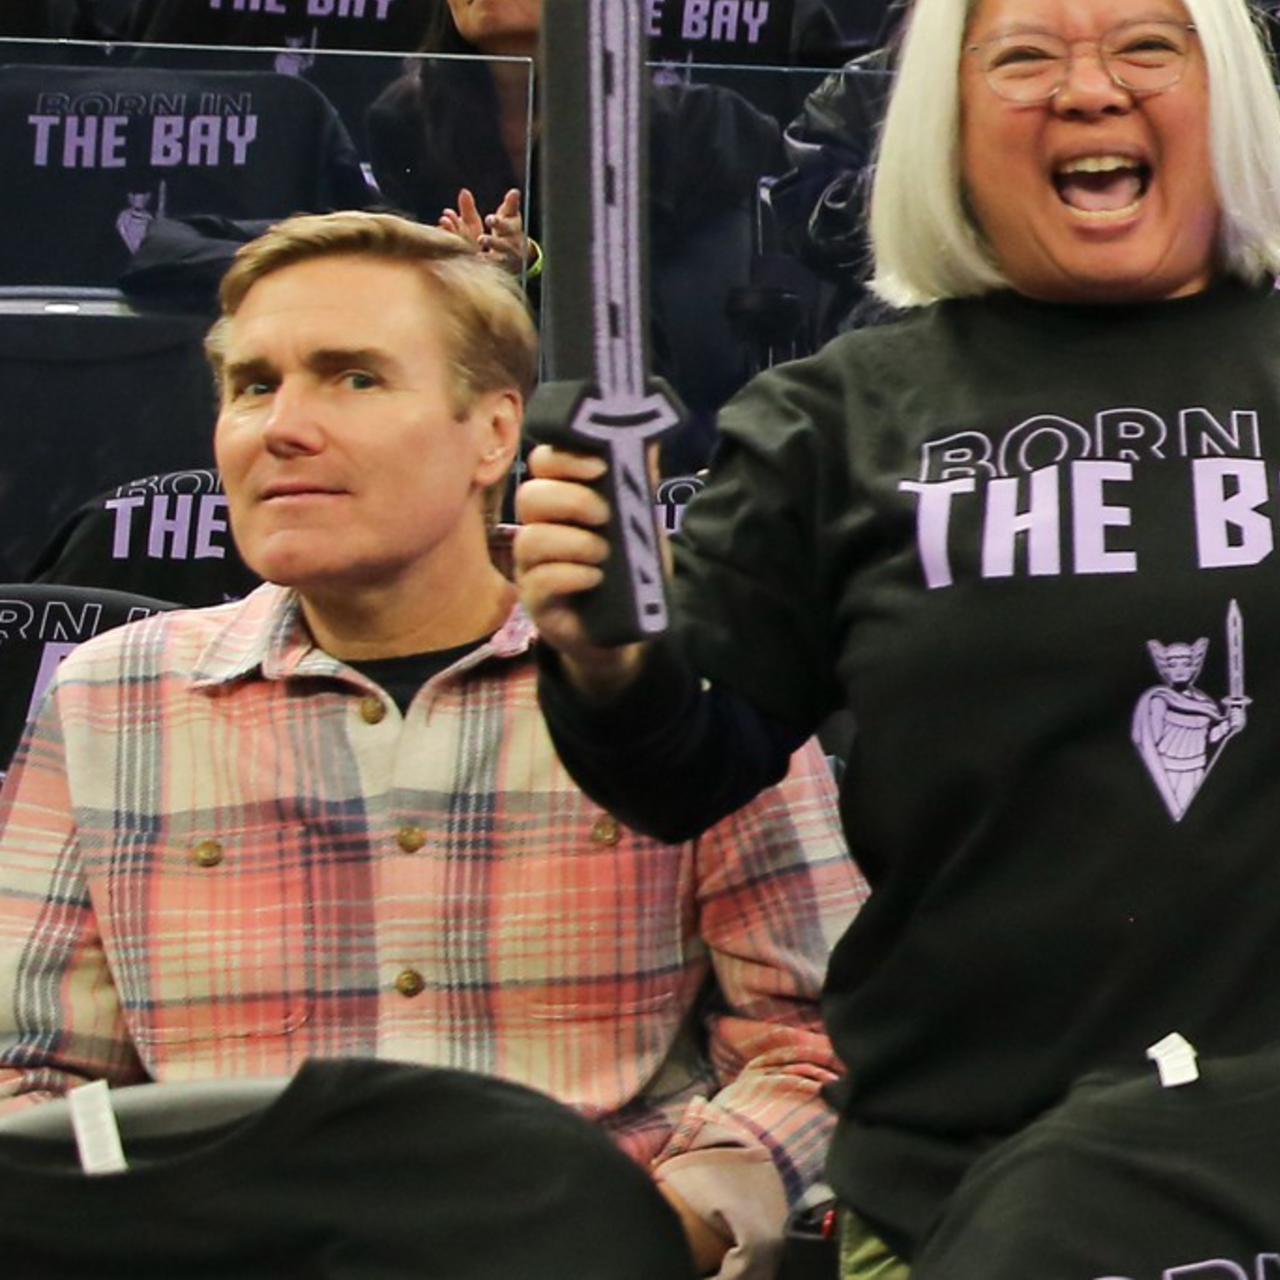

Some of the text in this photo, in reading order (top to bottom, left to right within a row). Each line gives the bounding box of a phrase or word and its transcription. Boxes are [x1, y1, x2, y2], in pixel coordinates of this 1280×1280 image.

[36, 91, 252, 117] BORN IN
[28, 115, 258, 168] THE BAY
[921, 408, 1262, 482] BORN
[105, 494, 228, 559] THE
[898, 460, 1137, 589] THE
